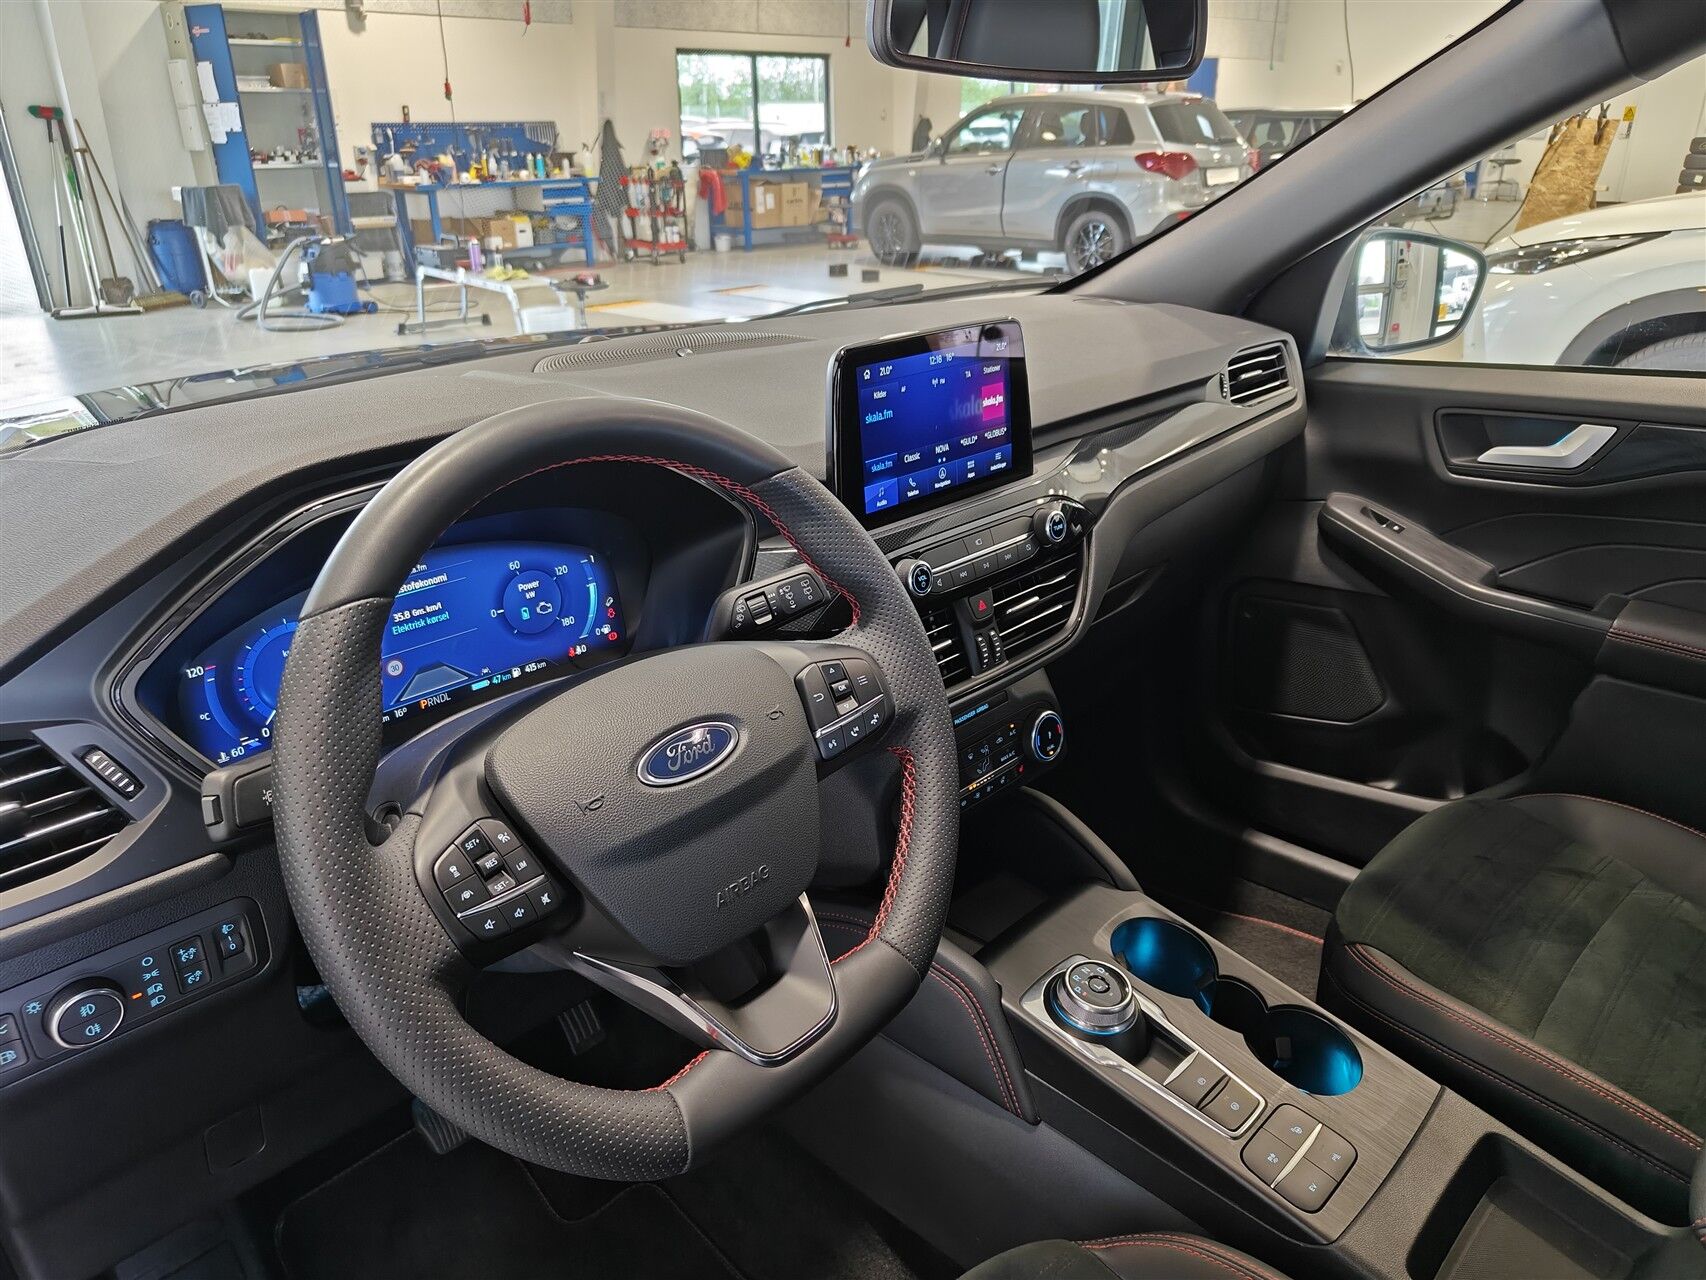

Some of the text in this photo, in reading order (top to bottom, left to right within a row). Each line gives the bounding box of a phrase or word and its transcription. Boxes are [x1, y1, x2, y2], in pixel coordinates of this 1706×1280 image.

[982, 394, 1004, 407] skala.fm
[865, 409, 894, 424] skala.fm
[935, 443, 950, 454] NOVA
[904, 452, 921, 464] Classic
[871, 460, 893, 473] skala.fm
[509, 560, 520, 571] 60
[555, 565, 568, 576] 120
[398, 572, 448, 594] stoføkonomi
[518, 580, 540, 592] Power
[393, 610, 411, 623] 35.8
[490, 609, 497, 618] 0
[392, 611, 450, 635] Elektrisk kørsel
[561, 616, 575, 627] 180
[186, 666, 204, 679] 120
[390, 664, 400, 673] 30
[525, 661, 547, 673] 415 km
[492, 673, 512, 685] 47 km
[261, 727, 270, 738] 0
[231, 746, 245, 758] 60
[666, 734, 716, 771] Ford
[485, 857, 498, 870] RES
[515, 860, 528, 871] LIM
[716, 864, 769, 909] AIRBAG
[1072, 974, 1081, 982] R
